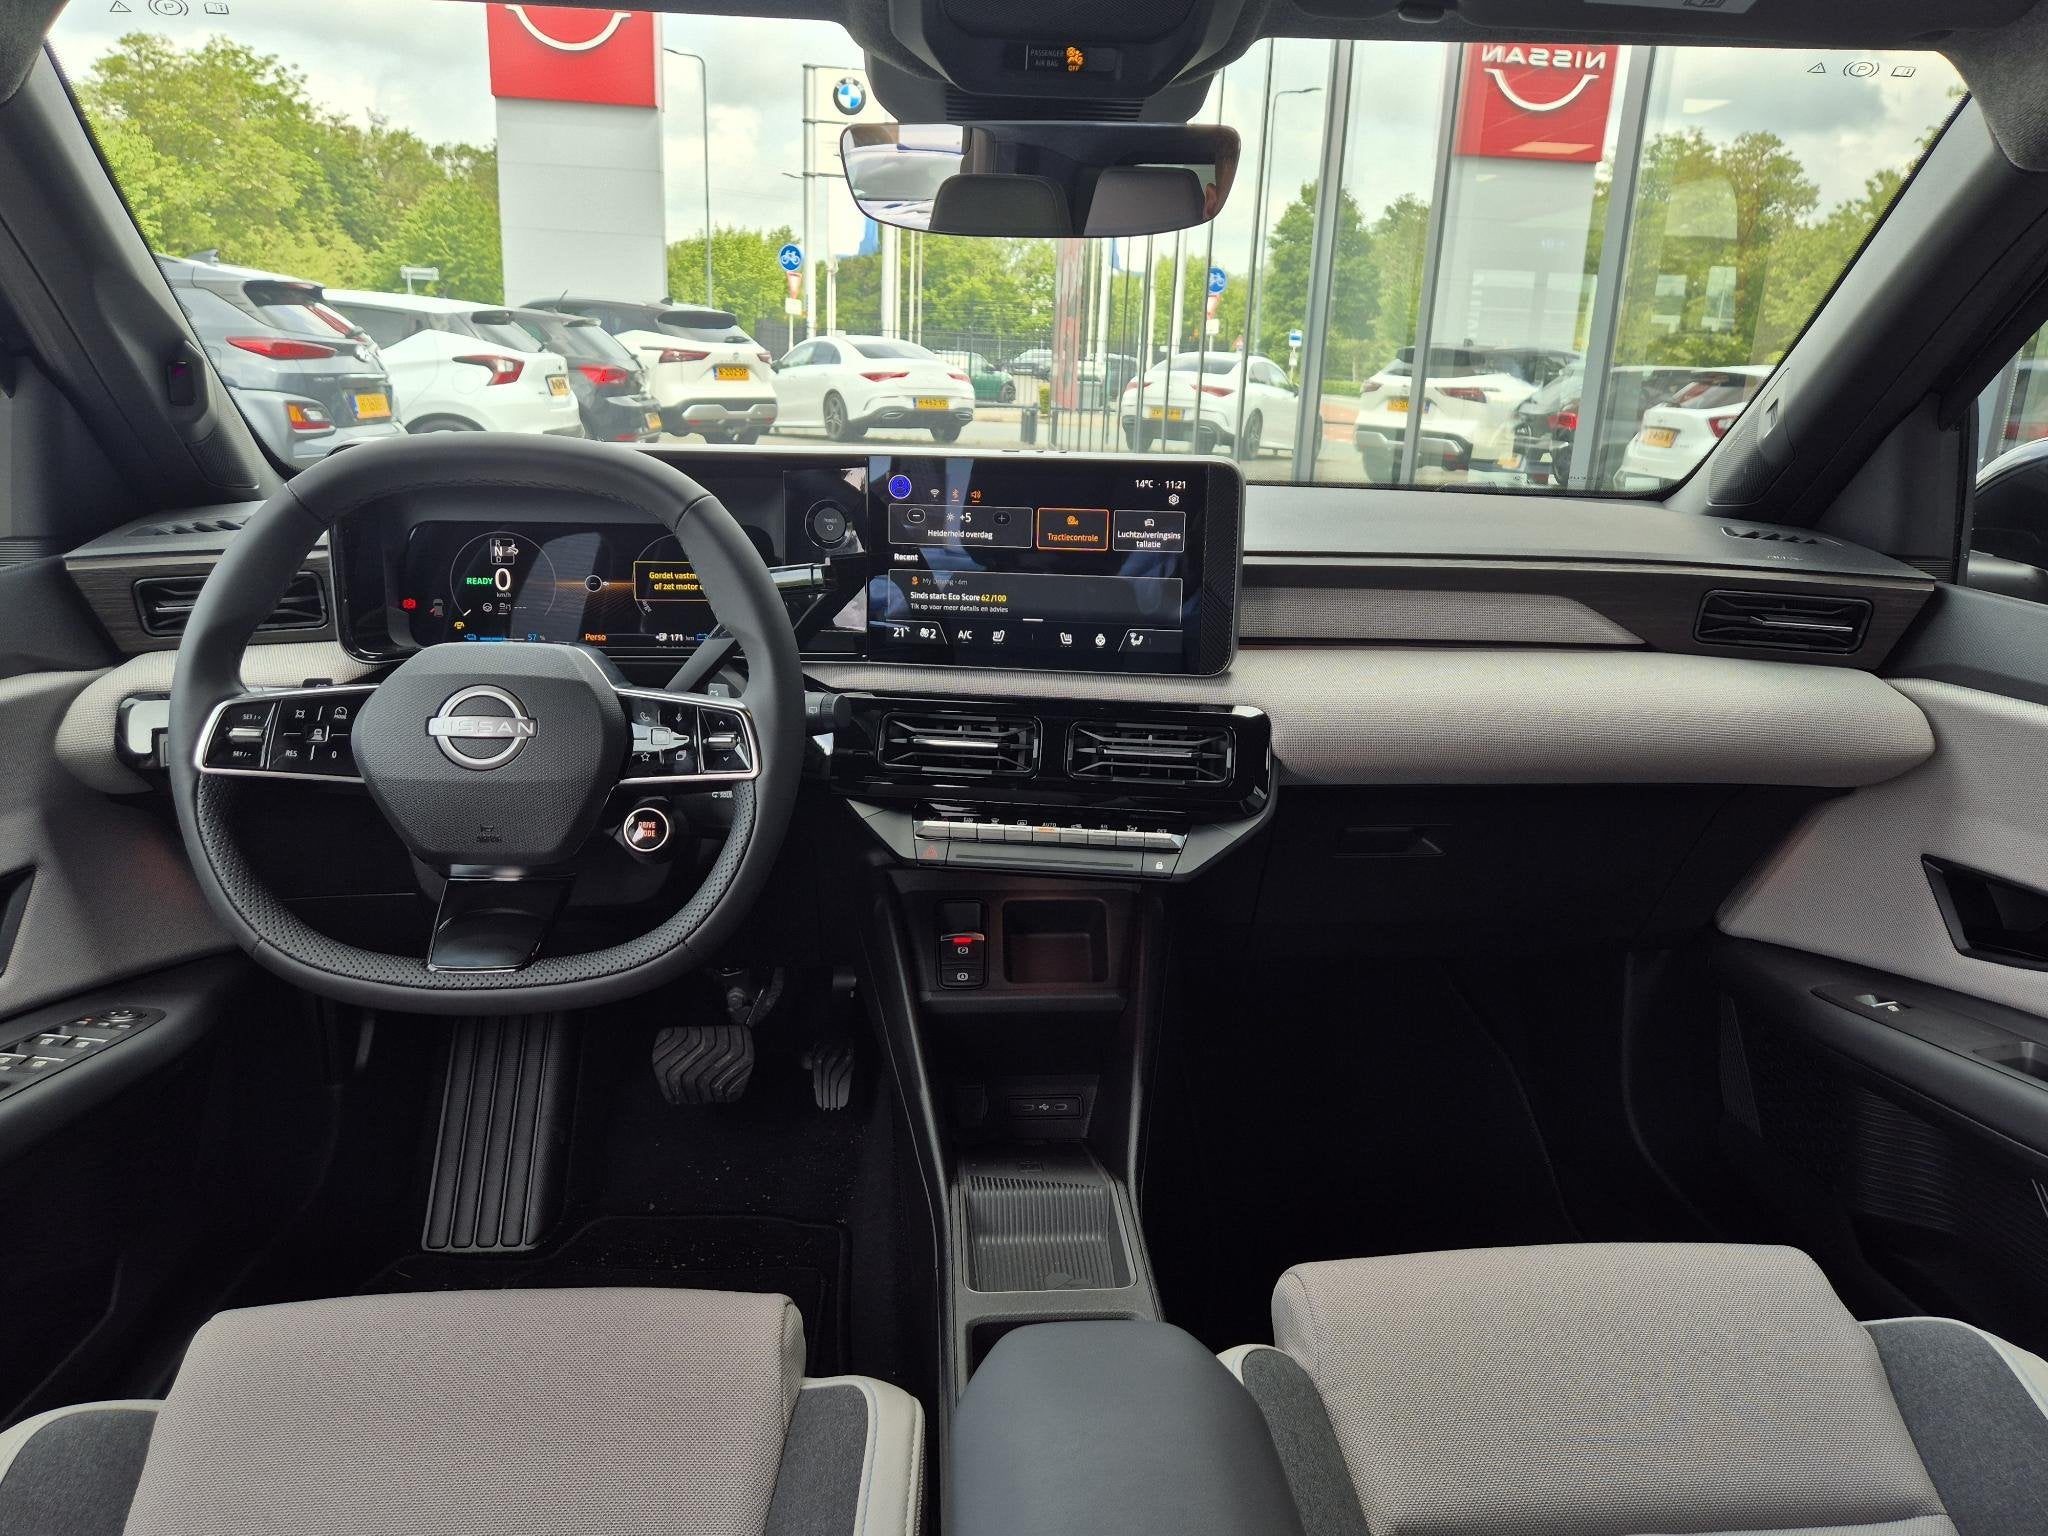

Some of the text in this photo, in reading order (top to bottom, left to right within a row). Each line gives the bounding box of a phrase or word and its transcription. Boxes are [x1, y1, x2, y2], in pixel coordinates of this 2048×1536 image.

[1030, 48, 1064, 57] PASSENGER
[1135, 480, 1186, 489] 14°C 11:21
[928, 529, 993, 540] Helderheid overdag
[1048, 532, 1098, 542] Tractiecontrole
[1117, 530, 1181, 540] Luchtzuiveringsins
[1136, 540, 1161, 548] tallatie
[494, 546, 502, 556] N
[894, 553, 918, 561] Recent
[494, 568, 512, 591] 0
[648, 571, 674, 580] Gordel
[910, 592, 929, 600] Sinds
[930, 592, 948, 600] start:
[585, 633, 606, 641] Perso
[958, 630, 973, 640] A/C
[434, 720, 534, 735] ISSAN
